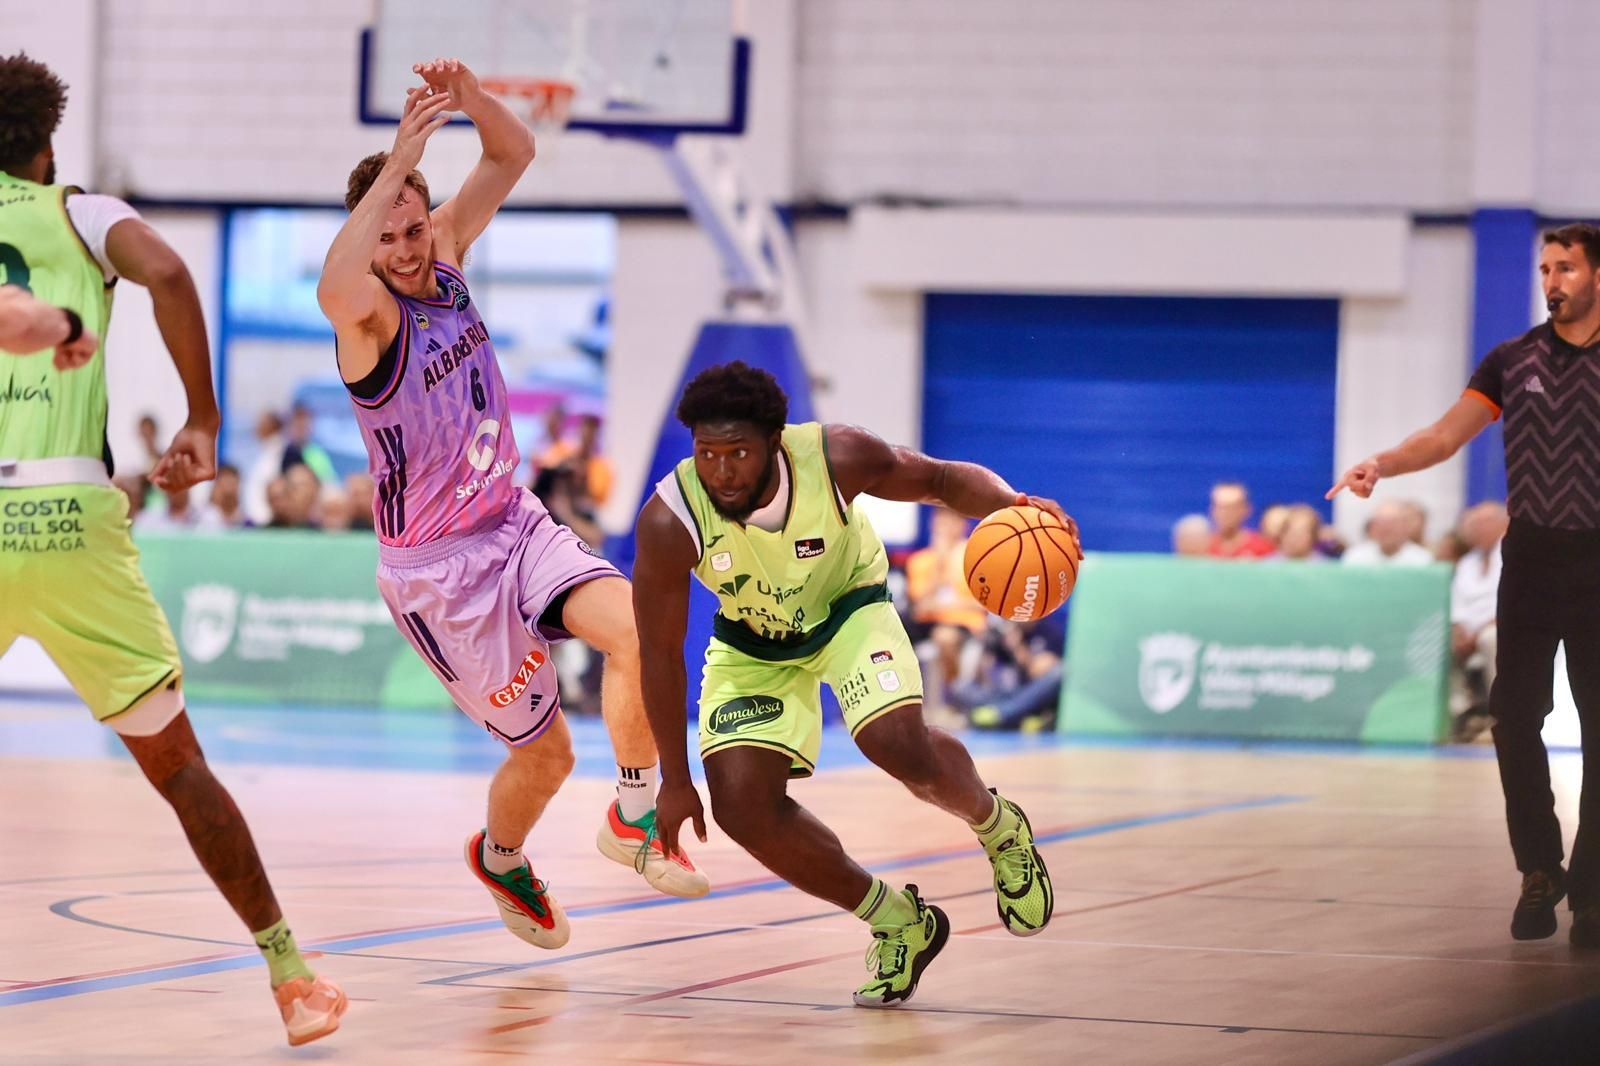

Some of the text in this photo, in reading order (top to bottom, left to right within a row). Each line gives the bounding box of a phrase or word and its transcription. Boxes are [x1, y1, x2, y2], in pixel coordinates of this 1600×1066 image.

[470, 367, 486, 412] 6
[4, 498, 82, 517] COSTA
[3, 519, 84, 536] DEL SOL
[2, 534, 86, 552] MÁLAGA
[495, 654, 541, 706] GAZI
